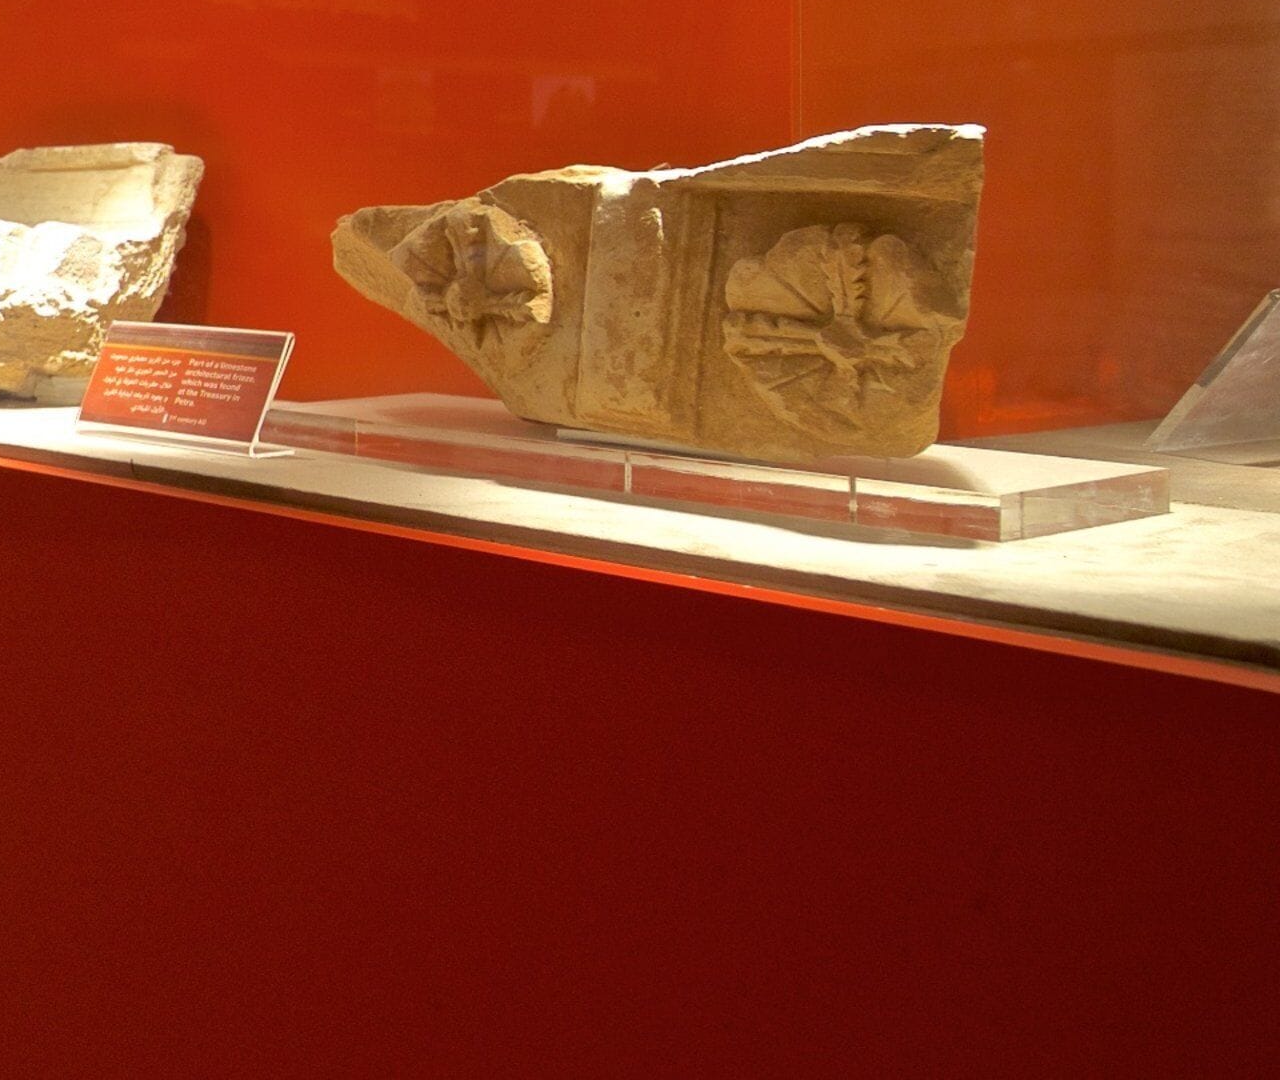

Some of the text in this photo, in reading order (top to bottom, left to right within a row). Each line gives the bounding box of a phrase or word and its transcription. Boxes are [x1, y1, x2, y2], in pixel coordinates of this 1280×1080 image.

[189, 358, 204, 367] Part
[205, 360, 214, 368] of
[185, 369, 232, 381] architectural
[181, 379, 202, 387] which
[219, 382, 241, 391] found
[200, 390, 232, 402] Treasury
[231, 394, 240, 402] in
